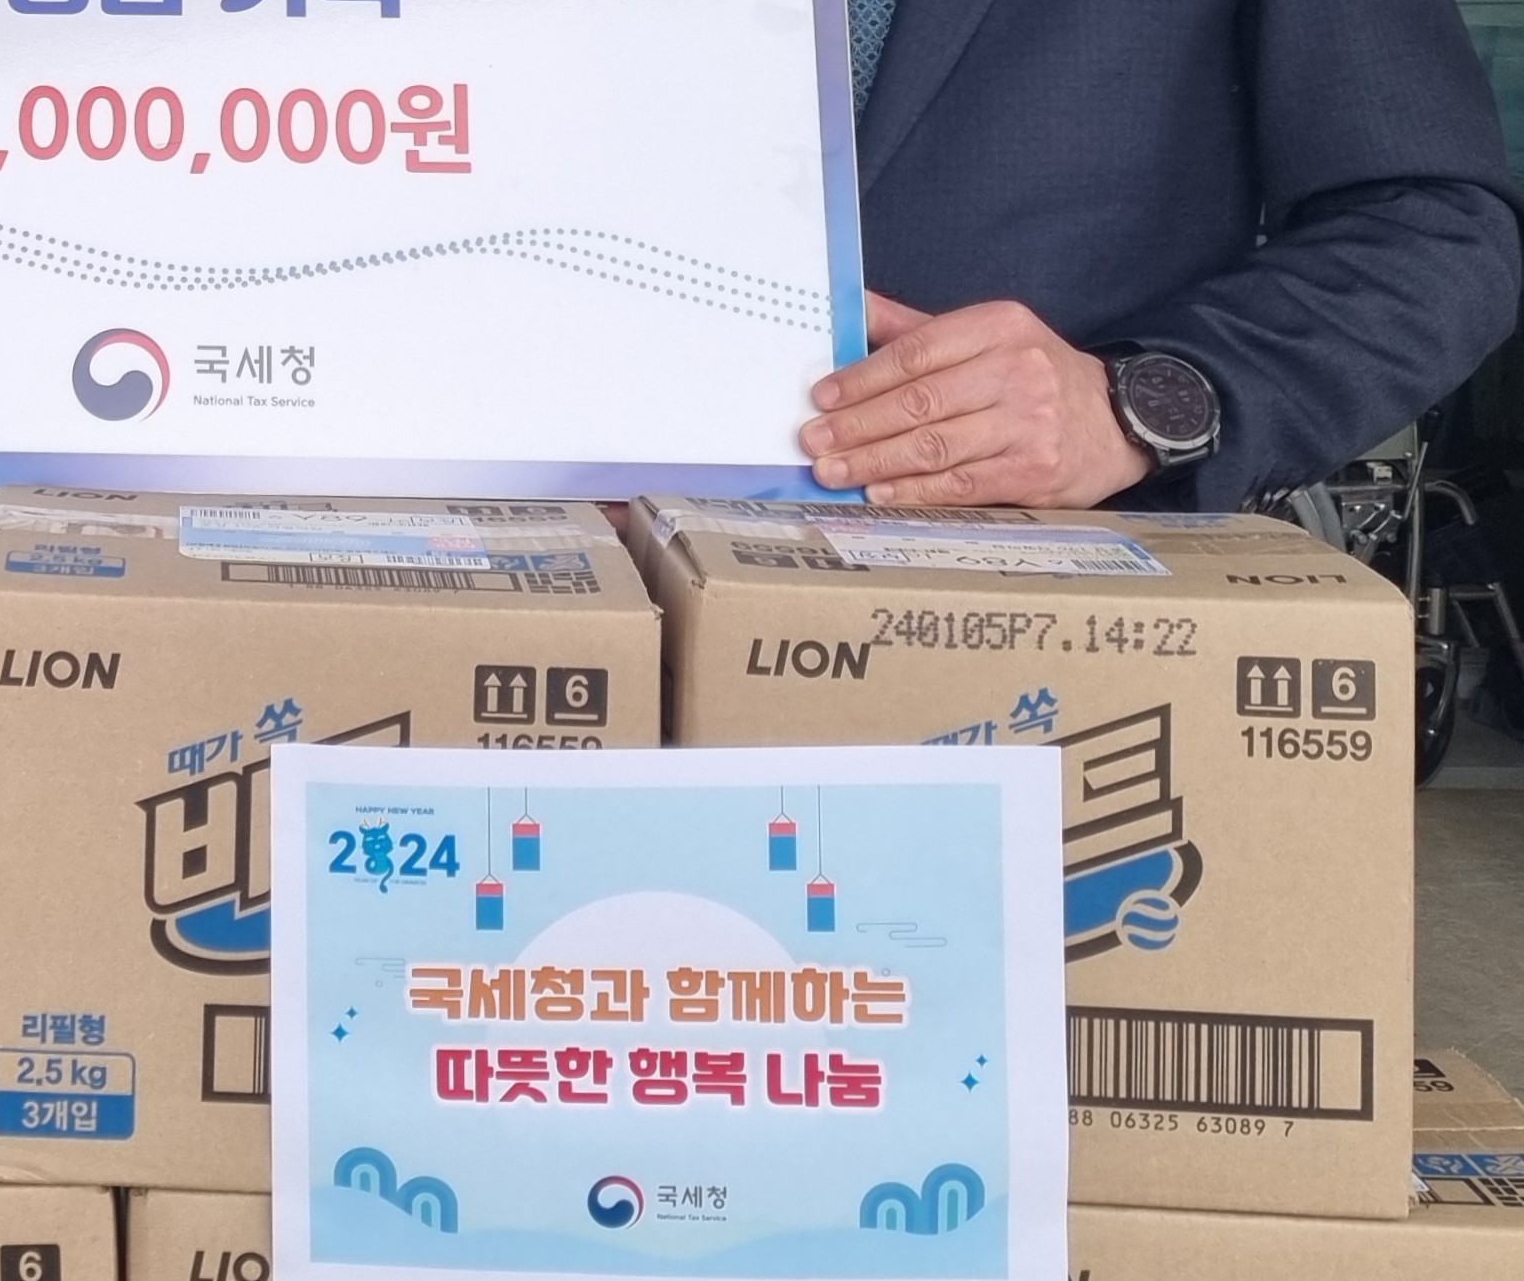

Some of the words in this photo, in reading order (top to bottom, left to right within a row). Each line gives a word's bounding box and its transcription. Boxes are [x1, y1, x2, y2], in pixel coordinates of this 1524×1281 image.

[194, 345, 316, 386] 국세청
[193, 394, 243, 407] National
[247, 396, 268, 407] Tax
[271, 396, 316, 408] Service
[33, 488, 139, 502] LION
[1226, 574, 1348, 586] LION
[871, 608, 1199, 656] 240105P7.14:22
[746, 638, 872, 679] LION
[564, 674, 589, 707] 6
[1331, 667, 1357, 702] 6
[1008, 687, 1060, 735] 쏙
[167, 730, 243, 777] 때가
[1240, 726, 1374, 762] 116559
[355, 806, 386, 814] HAPPY
[387, 807, 409, 815] NEW
[411, 807, 435, 816] YEAR
[407, 965, 650, 1024] 국세청과
[666, 966, 907, 1026] 함께하는
[21, 1013, 107, 1046] 리필형
[16, 1057, 63, 1087] 2.5
[70, 1058, 108, 1089] kg
[435, 1047, 613, 1105] 따뜻한
[628, 1048, 748, 1106] 행복
[765, 1051, 883, 1109] 나눔
[21, 1100, 98, 1132] 3개입
[1109, 1110, 1180, 1132] 06325
[1195, 1115, 1266, 1136] 63089
[1282, 1119, 1296, 1138] 7
[657, 1184, 728, 1210] 국세청
[656, 1213, 686, 1221] National
[701, 1214, 727, 1222] Service
